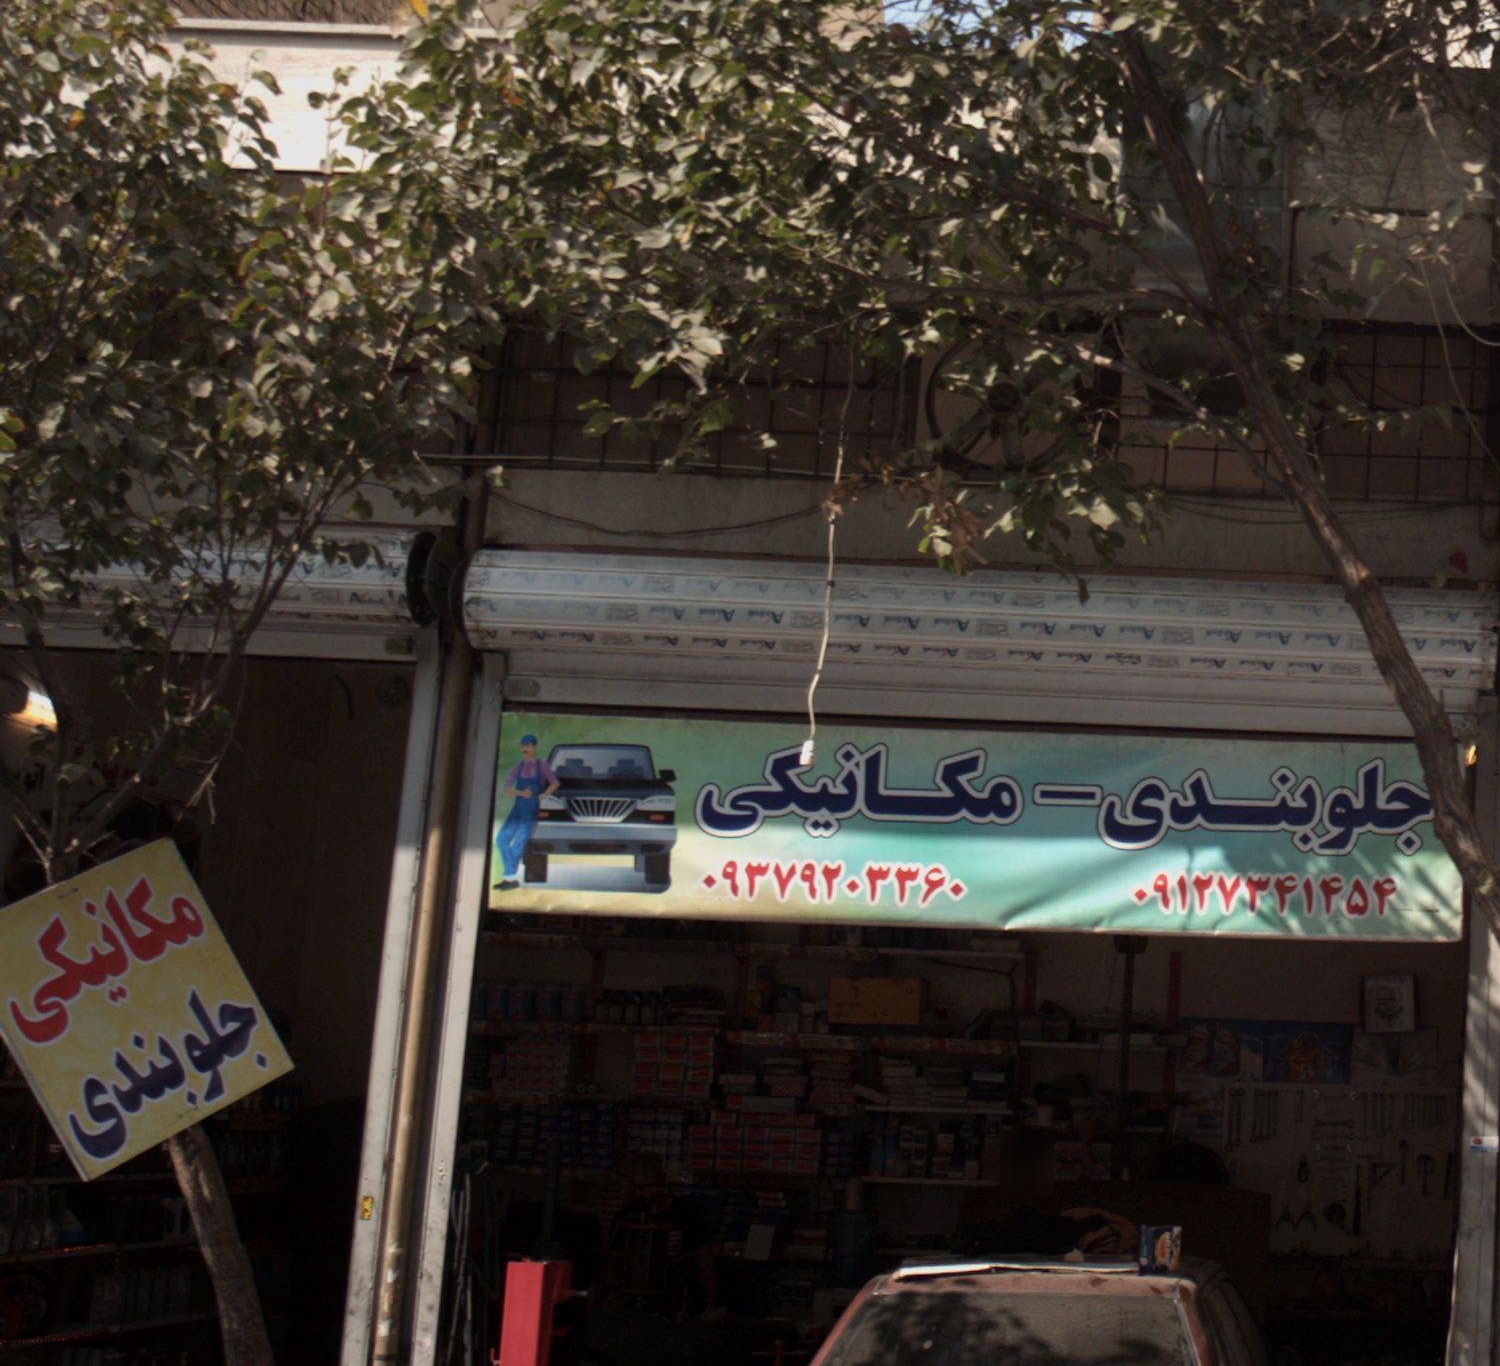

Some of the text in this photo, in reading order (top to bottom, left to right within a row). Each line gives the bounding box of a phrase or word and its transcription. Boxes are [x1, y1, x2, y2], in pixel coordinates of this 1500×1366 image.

[694, 742, 1024, 838] مکانیکی
[1098, 757, 1436, 856] جلوبندی
[702, 859, 1400, 920] ۰۹۳۷۹۲۰۳۳۶۰ ۰۹۱۲۷۳۴۱۴۵۴
[9, 874, 206, 1046] مکانیکی
[68, 986, 269, 1161] جلوبندی
